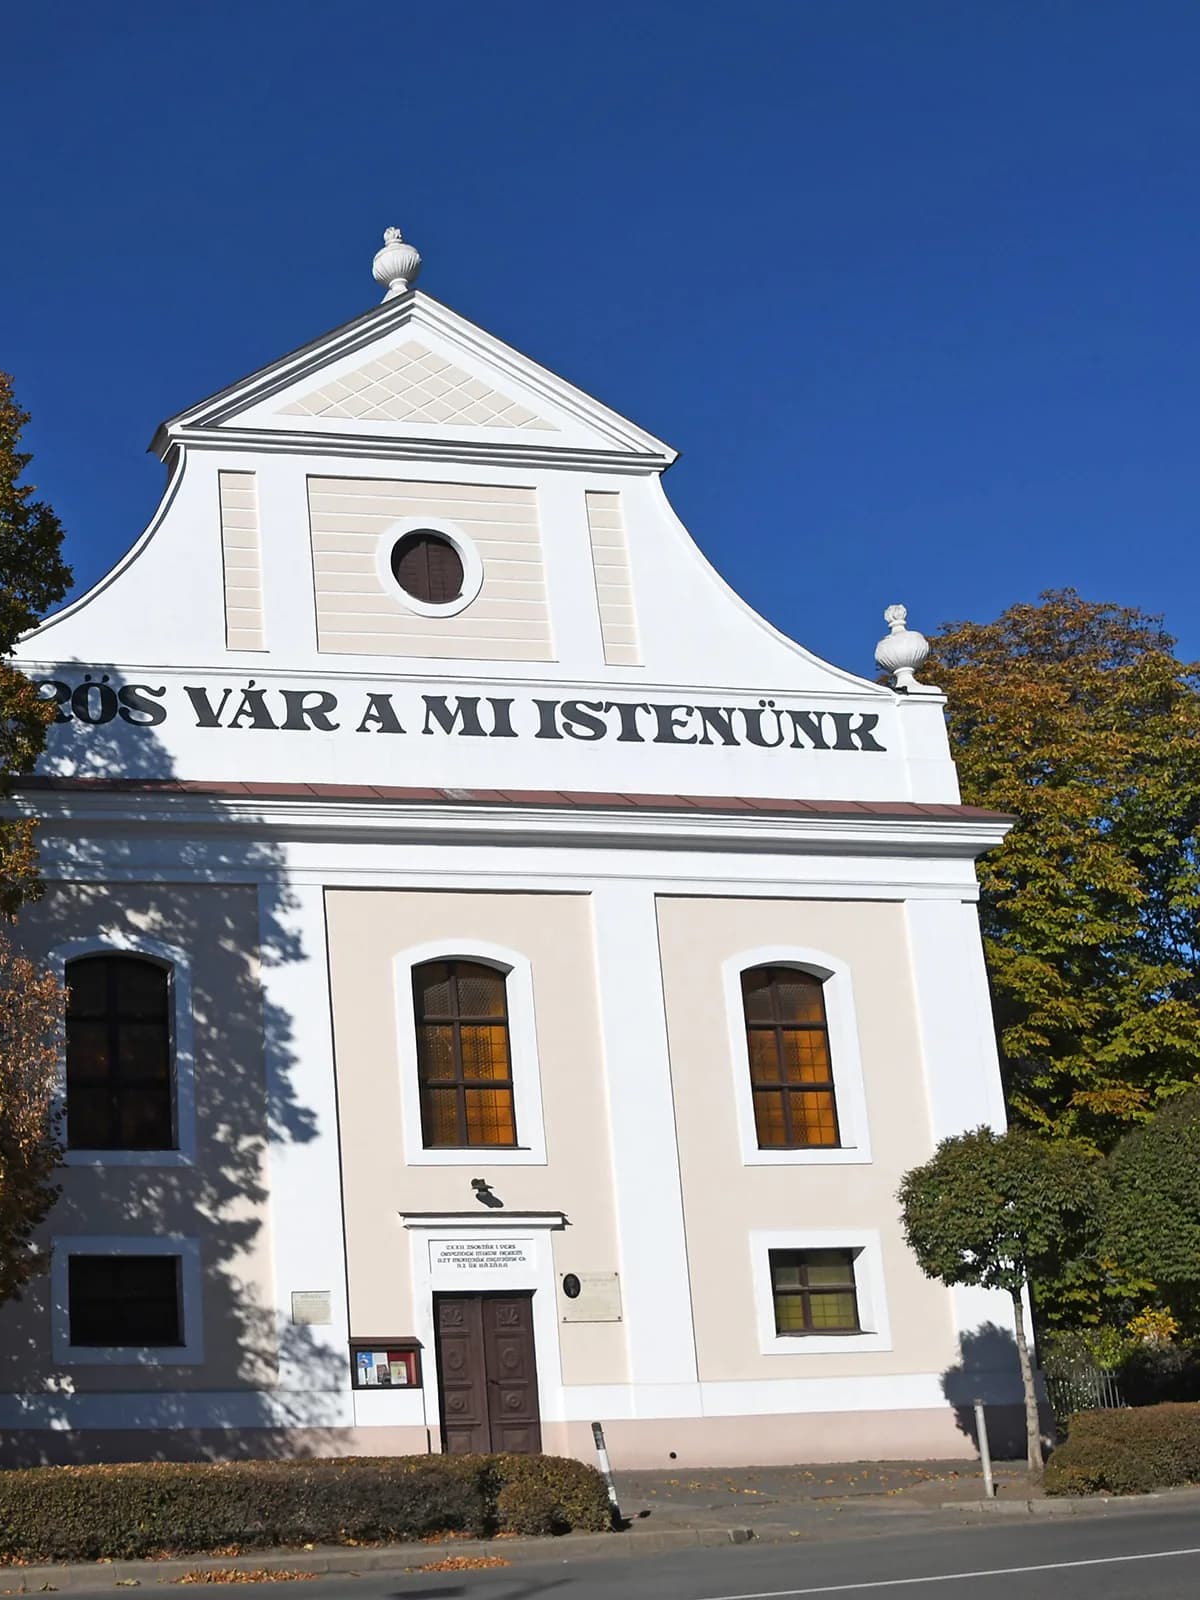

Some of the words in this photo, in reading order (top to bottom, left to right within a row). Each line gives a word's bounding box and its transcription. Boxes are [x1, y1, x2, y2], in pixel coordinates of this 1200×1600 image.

[36, 674, 167, 727] RÖS
[183, 680, 340, 732] VÁR
[356, 693, 406, 734] A
[421, 695, 519, 738] MI
[532, 699, 888, 752] ISTENÜNK
